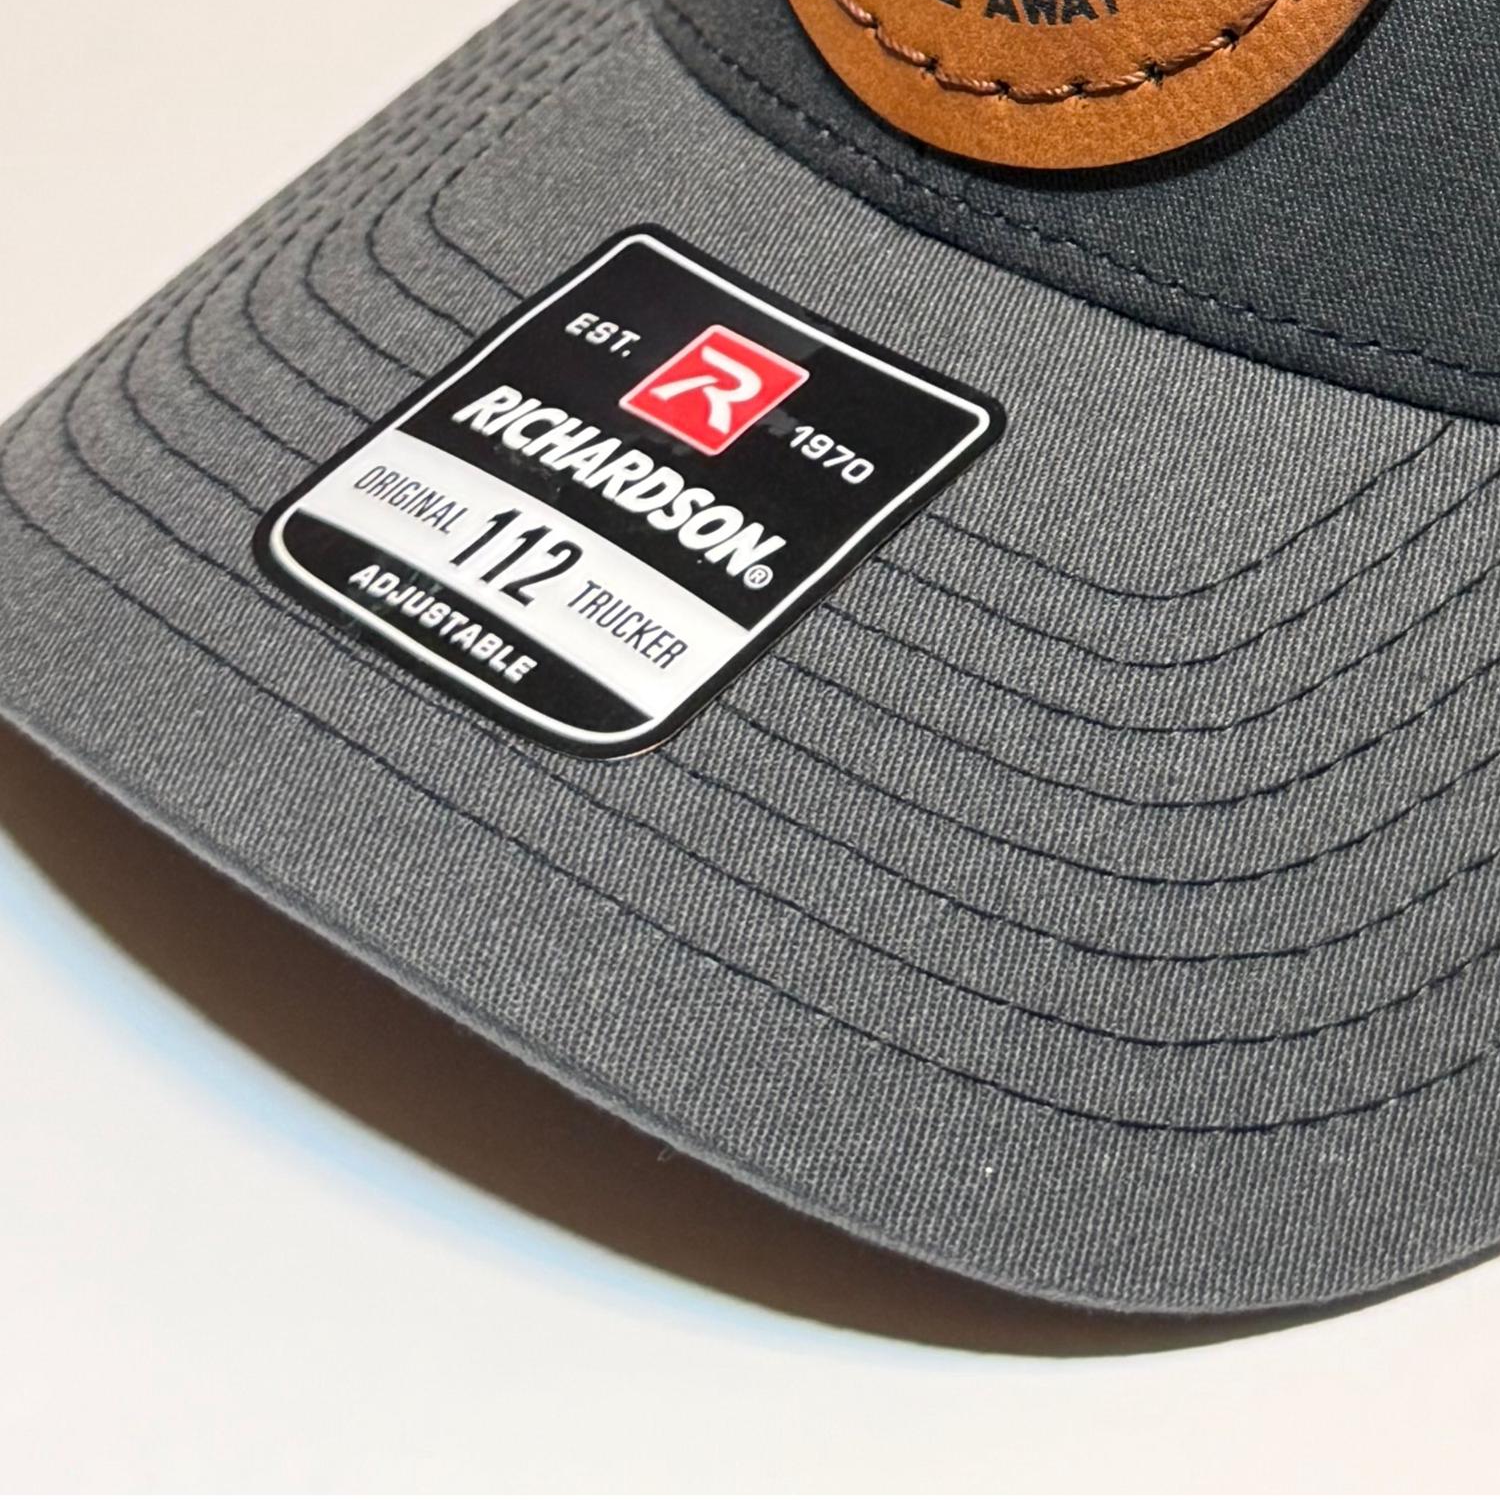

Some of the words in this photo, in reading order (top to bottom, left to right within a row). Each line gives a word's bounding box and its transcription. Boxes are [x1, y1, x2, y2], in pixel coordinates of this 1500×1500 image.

[565, 312, 641, 358] EST.
[790, 425, 875, 484] 1970
[348, 564, 538, 683] ADJUSTABLE
[354, 465, 468, 534] ORIGINAL
[450, 508, 584, 607] 112
[567, 580, 689, 670] TRUCKER
